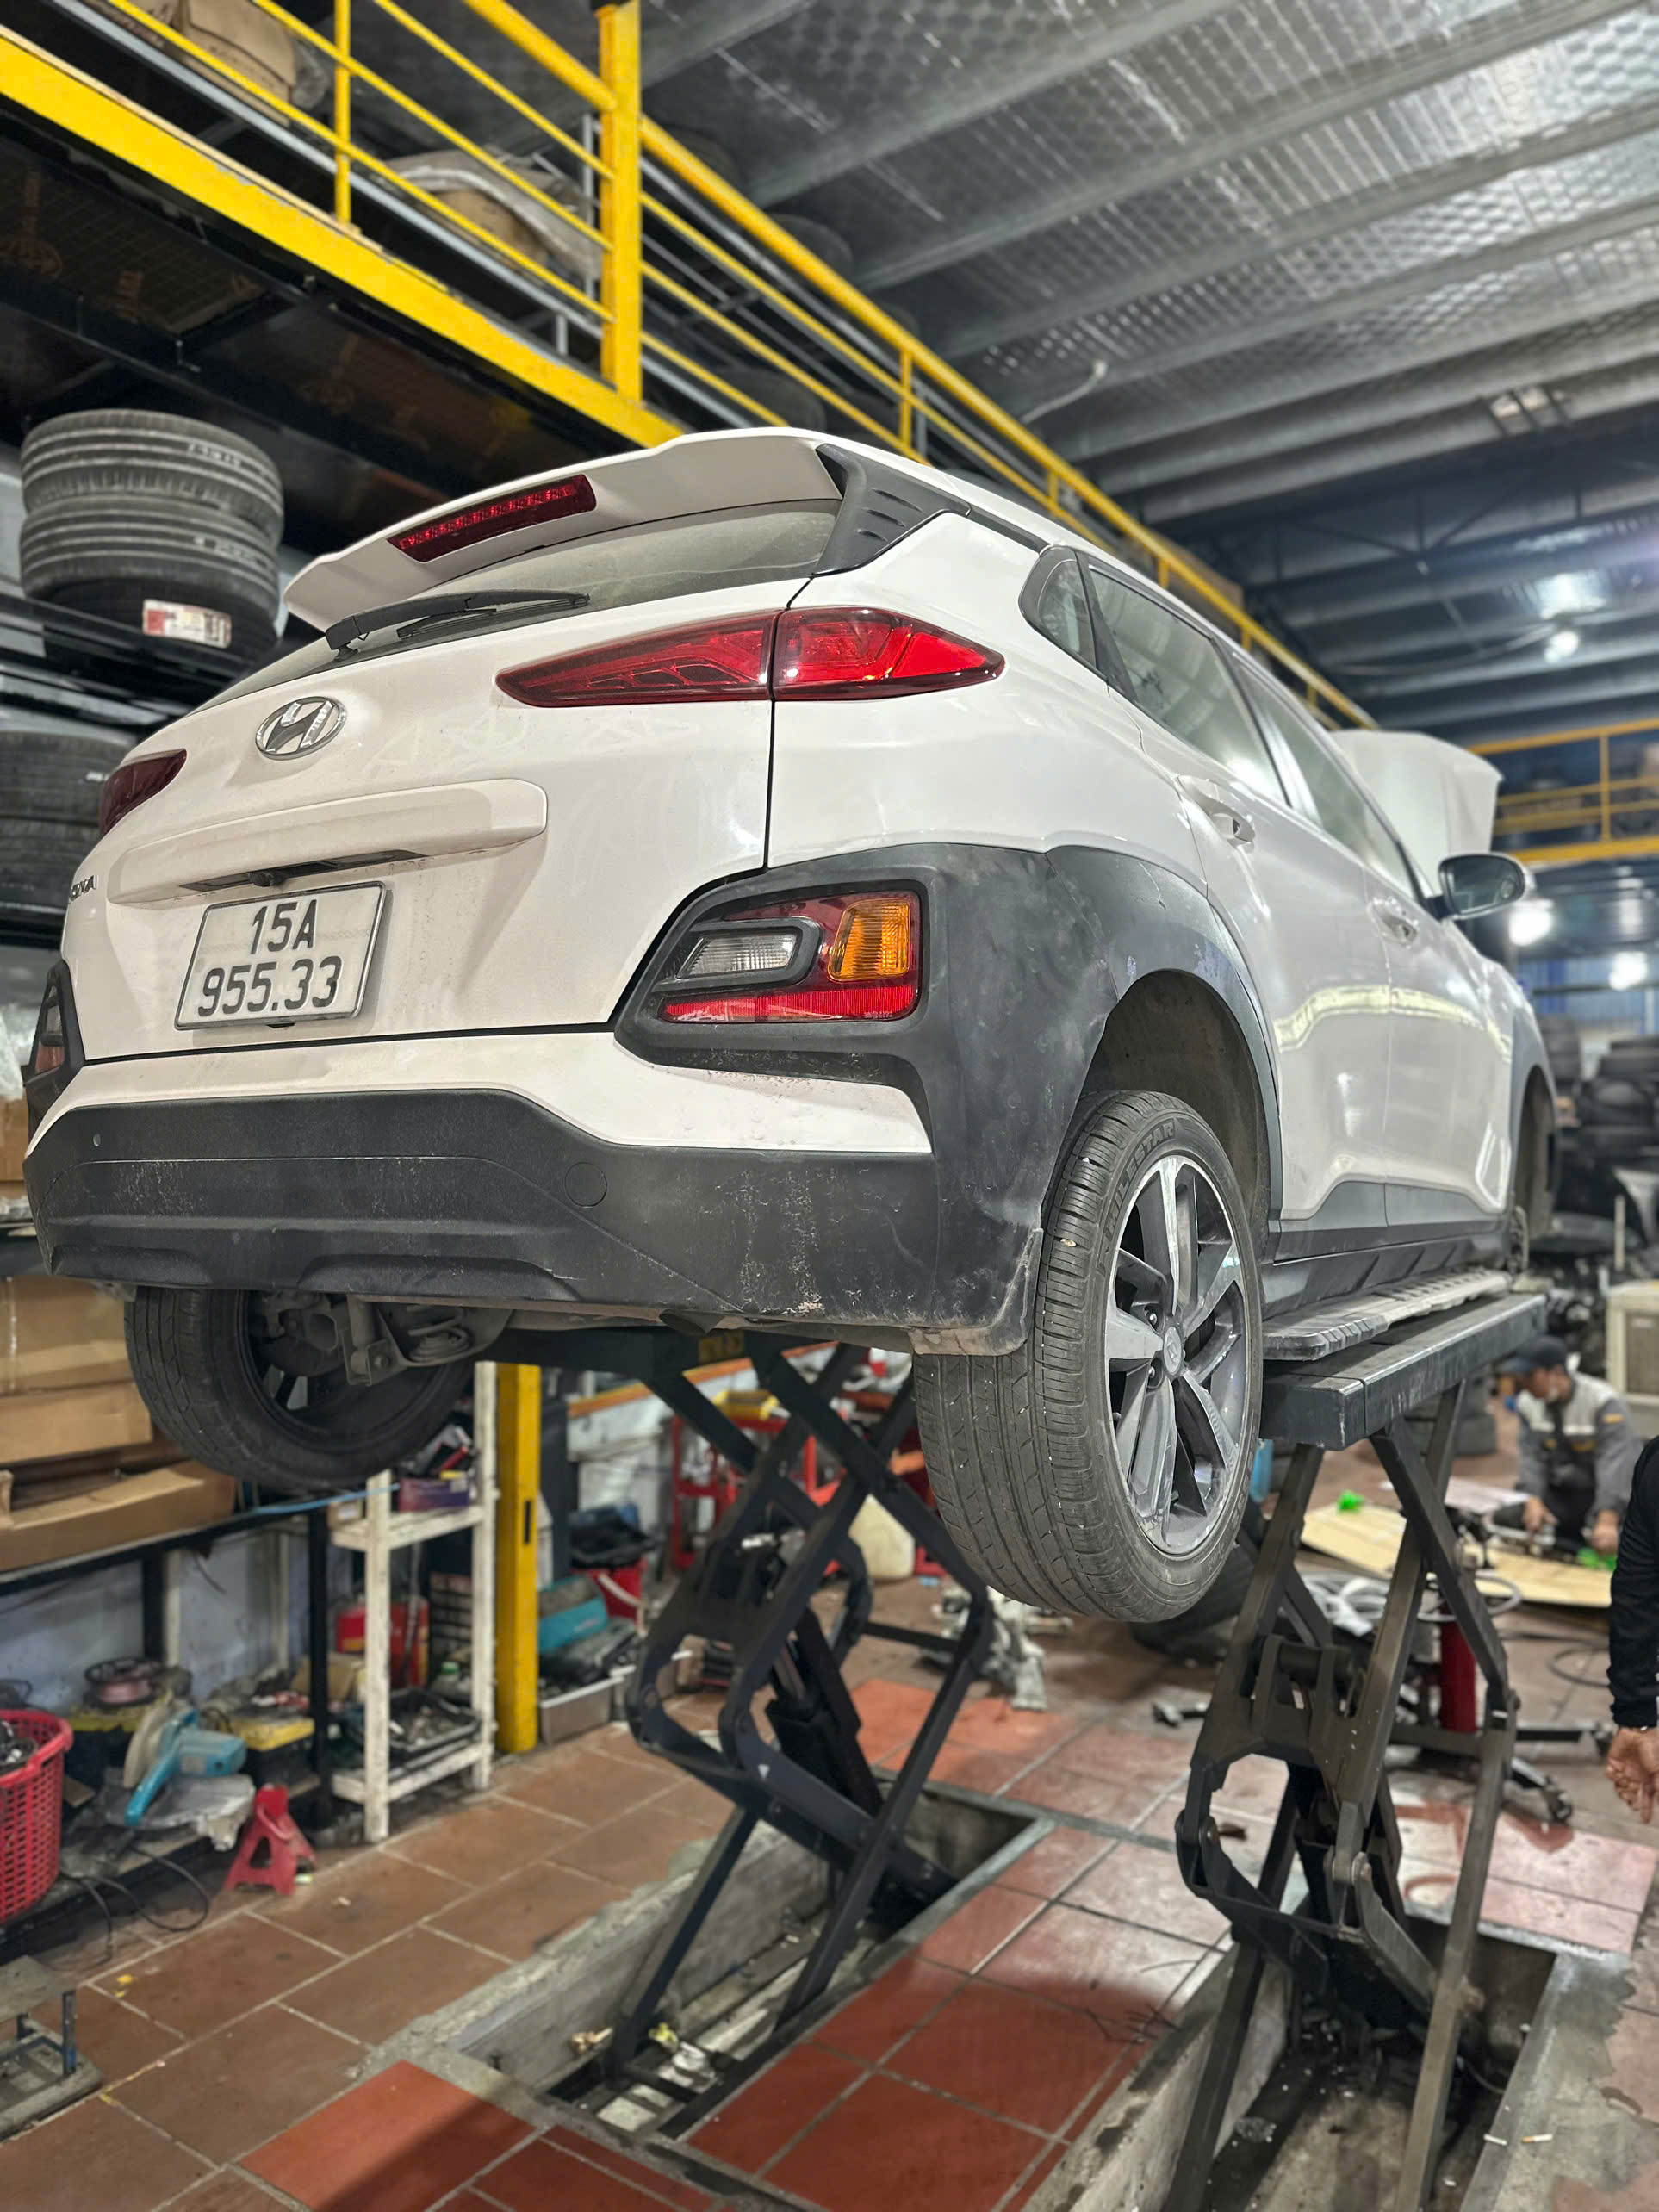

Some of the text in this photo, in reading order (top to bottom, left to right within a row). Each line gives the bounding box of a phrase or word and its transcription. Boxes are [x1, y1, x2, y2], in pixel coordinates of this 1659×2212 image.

[70, 874, 96, 901] ONA
[250, 898, 318, 955] 15A
[197, 955, 343, 1017] 955.33
[1104, 1121, 1176, 1241] MILESTAR
